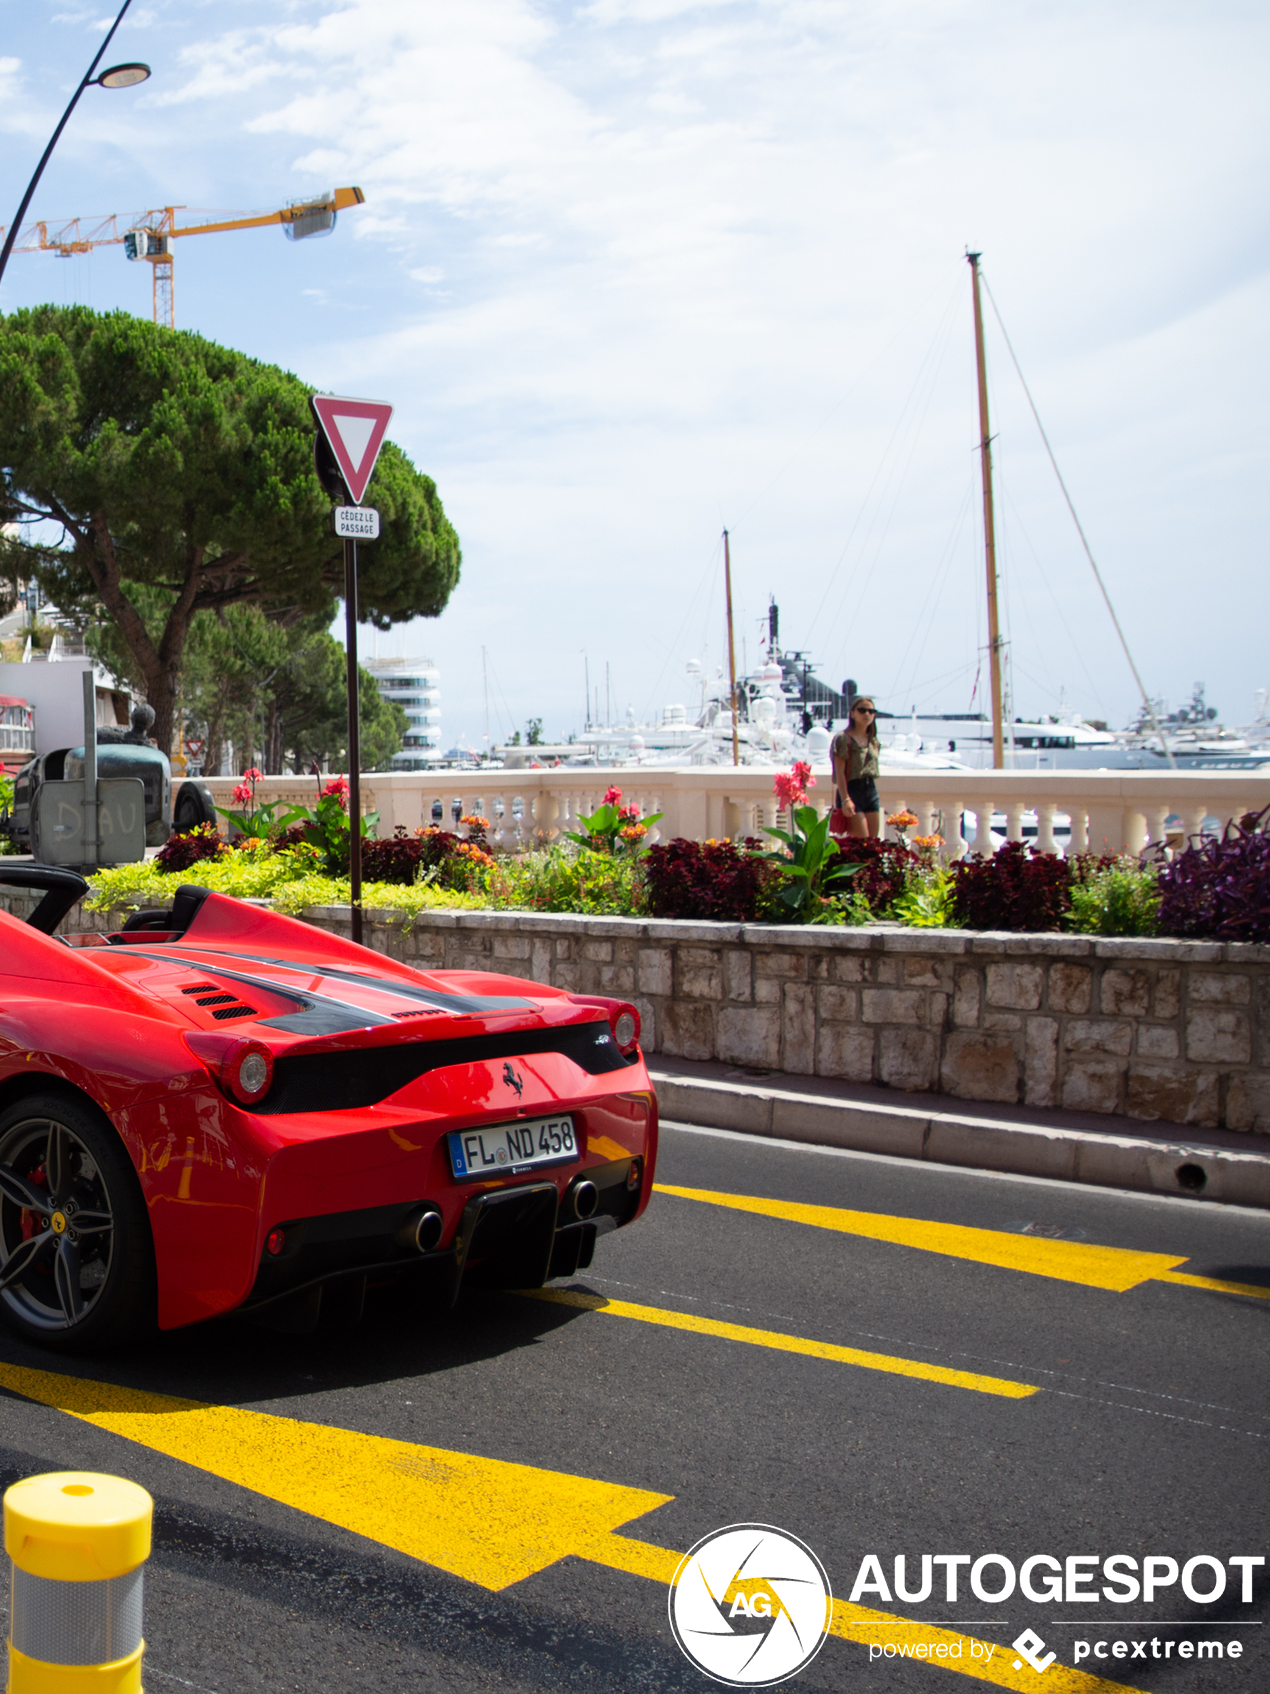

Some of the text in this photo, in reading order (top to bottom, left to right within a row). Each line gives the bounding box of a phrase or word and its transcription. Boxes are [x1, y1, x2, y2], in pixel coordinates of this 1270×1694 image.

[340, 510, 374, 522] CÉDEZ LE
[340, 523, 374, 534] PASSAGE
[464, 1121, 574, 1168] FL ND 458
[456, 1159, 462, 1169] D
